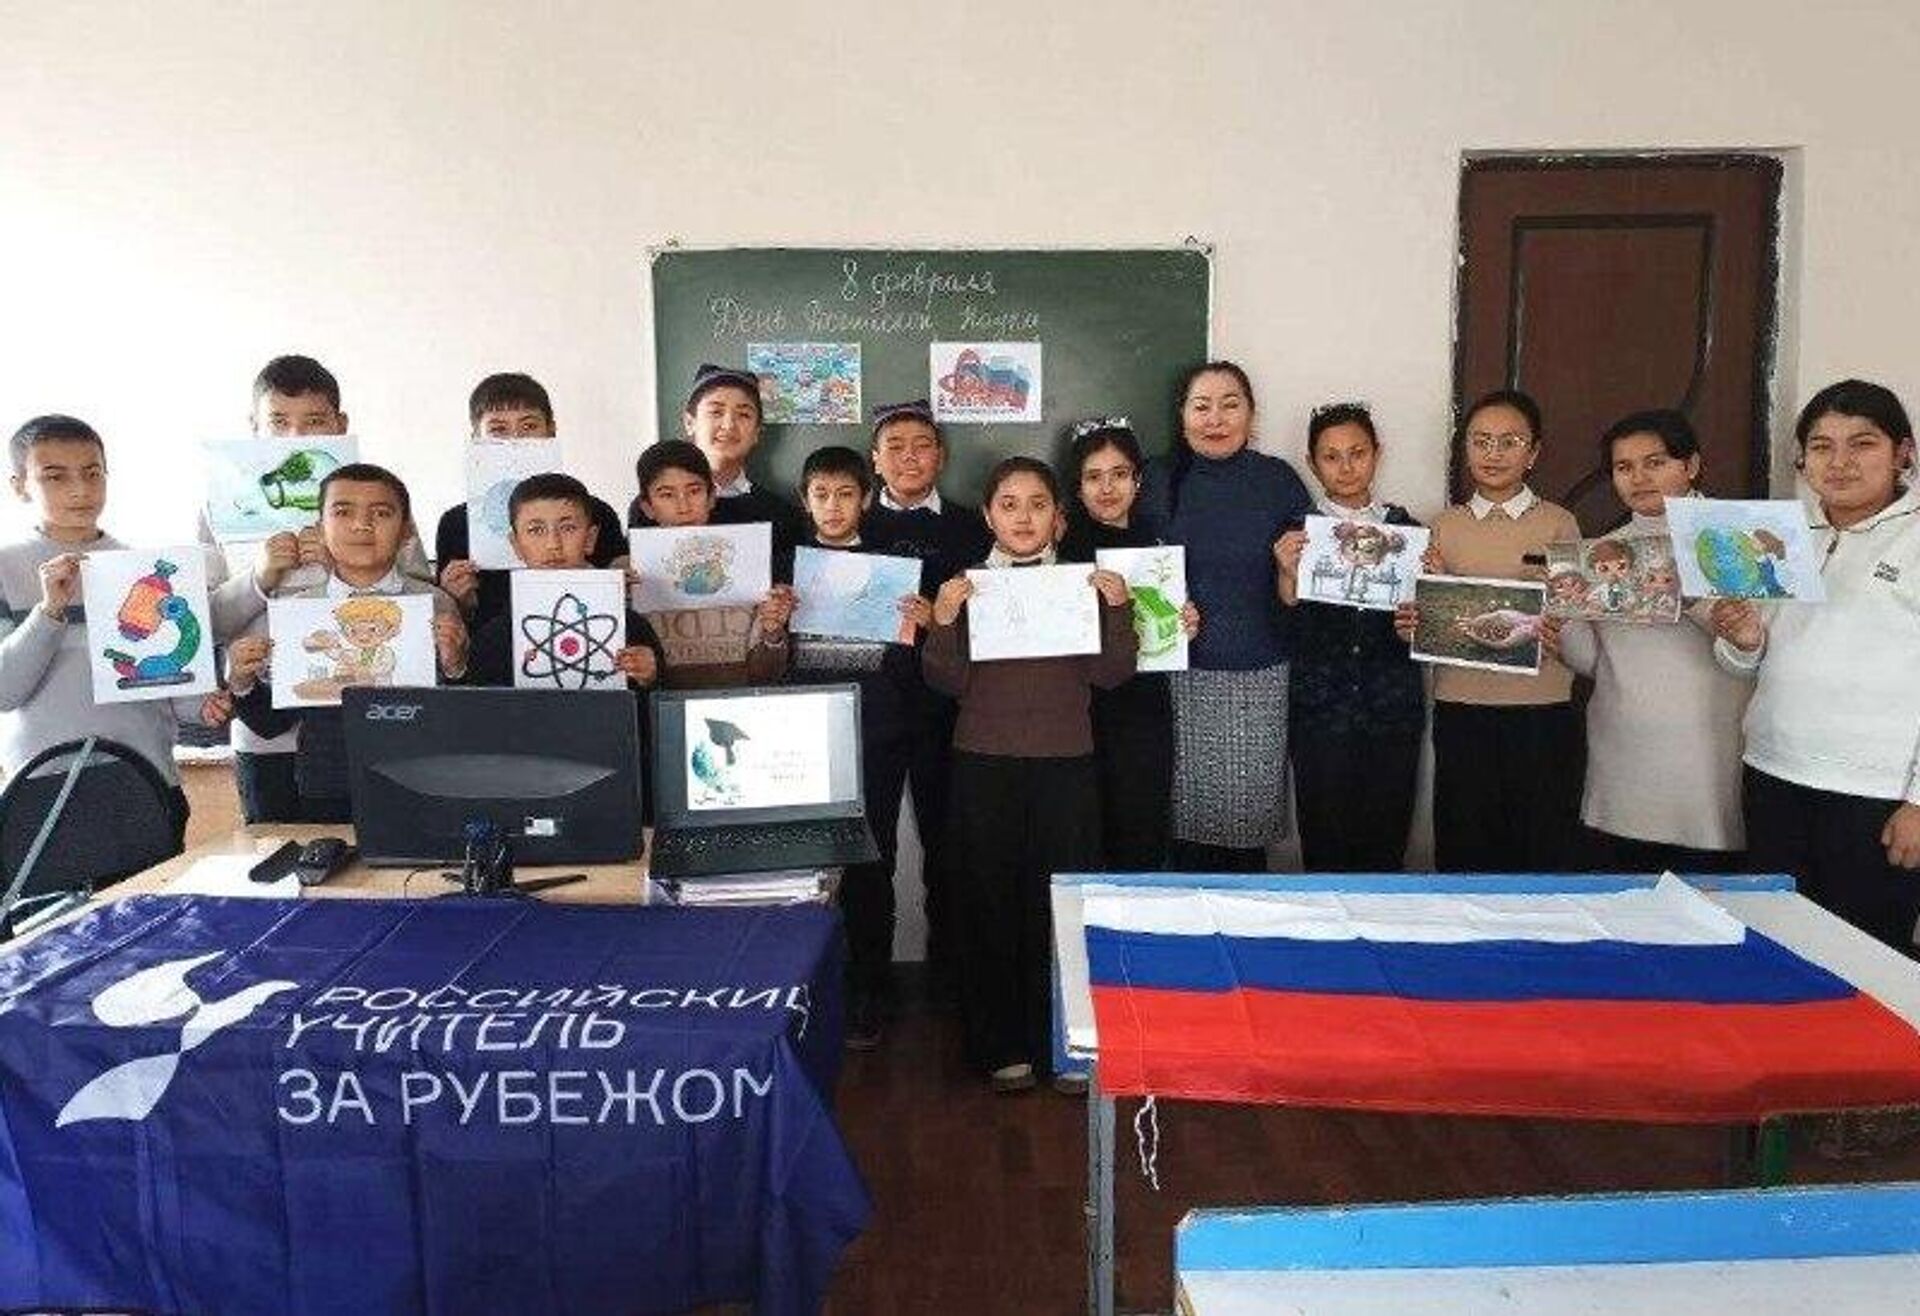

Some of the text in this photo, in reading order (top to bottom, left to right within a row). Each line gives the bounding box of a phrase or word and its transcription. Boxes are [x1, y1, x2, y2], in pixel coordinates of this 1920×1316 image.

[842, 259, 857, 300] 8
[366, 704, 422, 720] acer
[285, 1012, 626, 1053] УЧИТЕЛЬ
[278, 1069, 773, 1126] ЗА РУБЕЖОМ
